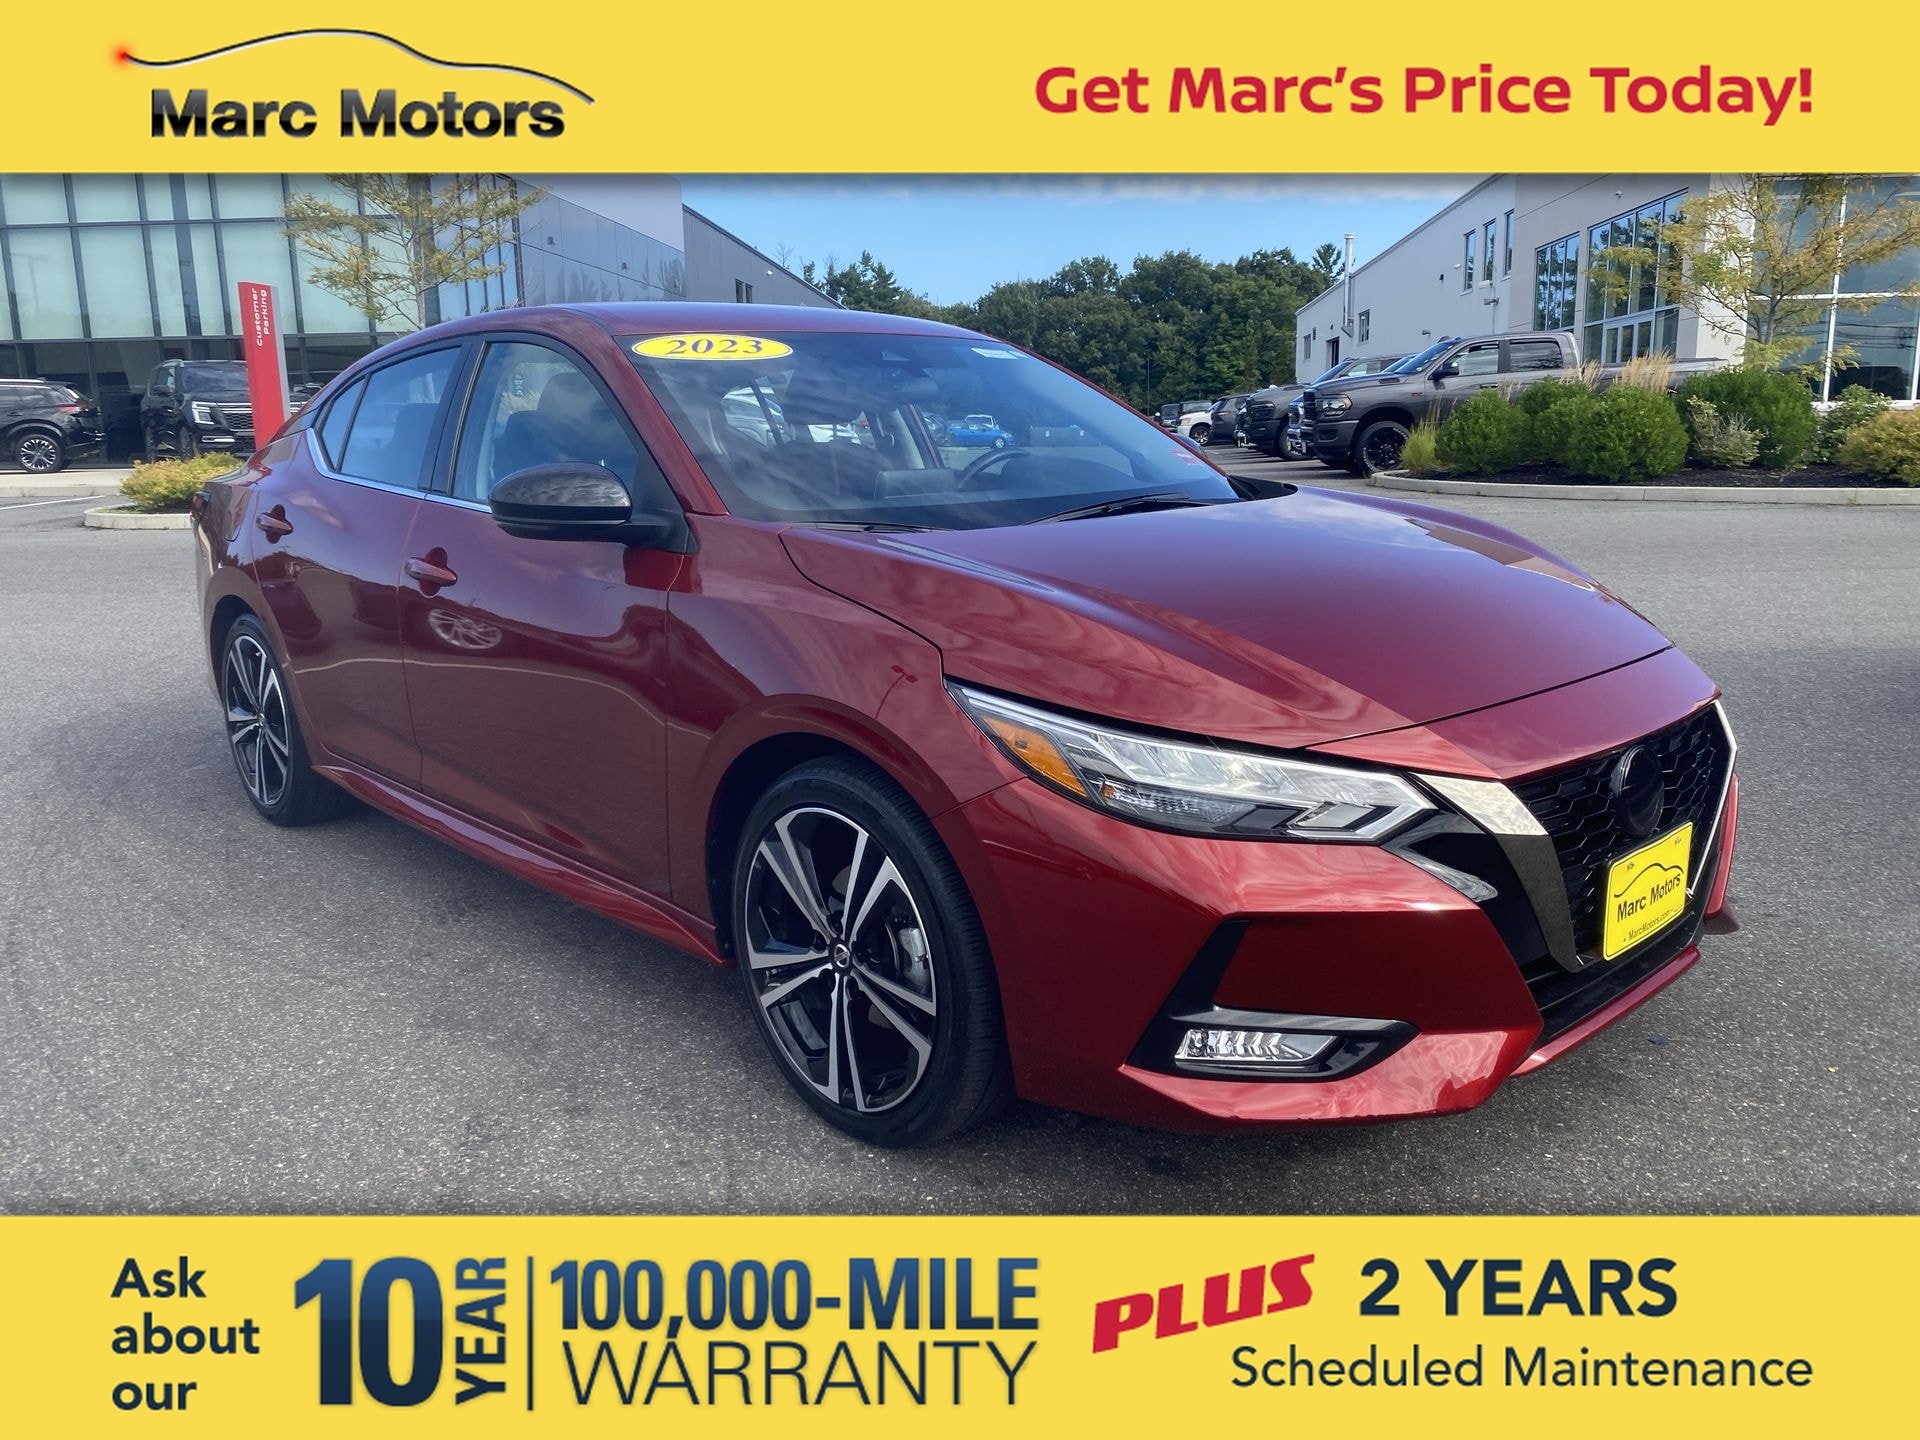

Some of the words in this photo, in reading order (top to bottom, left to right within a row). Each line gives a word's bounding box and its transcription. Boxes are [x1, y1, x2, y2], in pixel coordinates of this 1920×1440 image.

[665, 338, 763, 355] 2023
[1617, 896, 1646, 922] Marc
[1650, 873, 1681, 905] Motors
